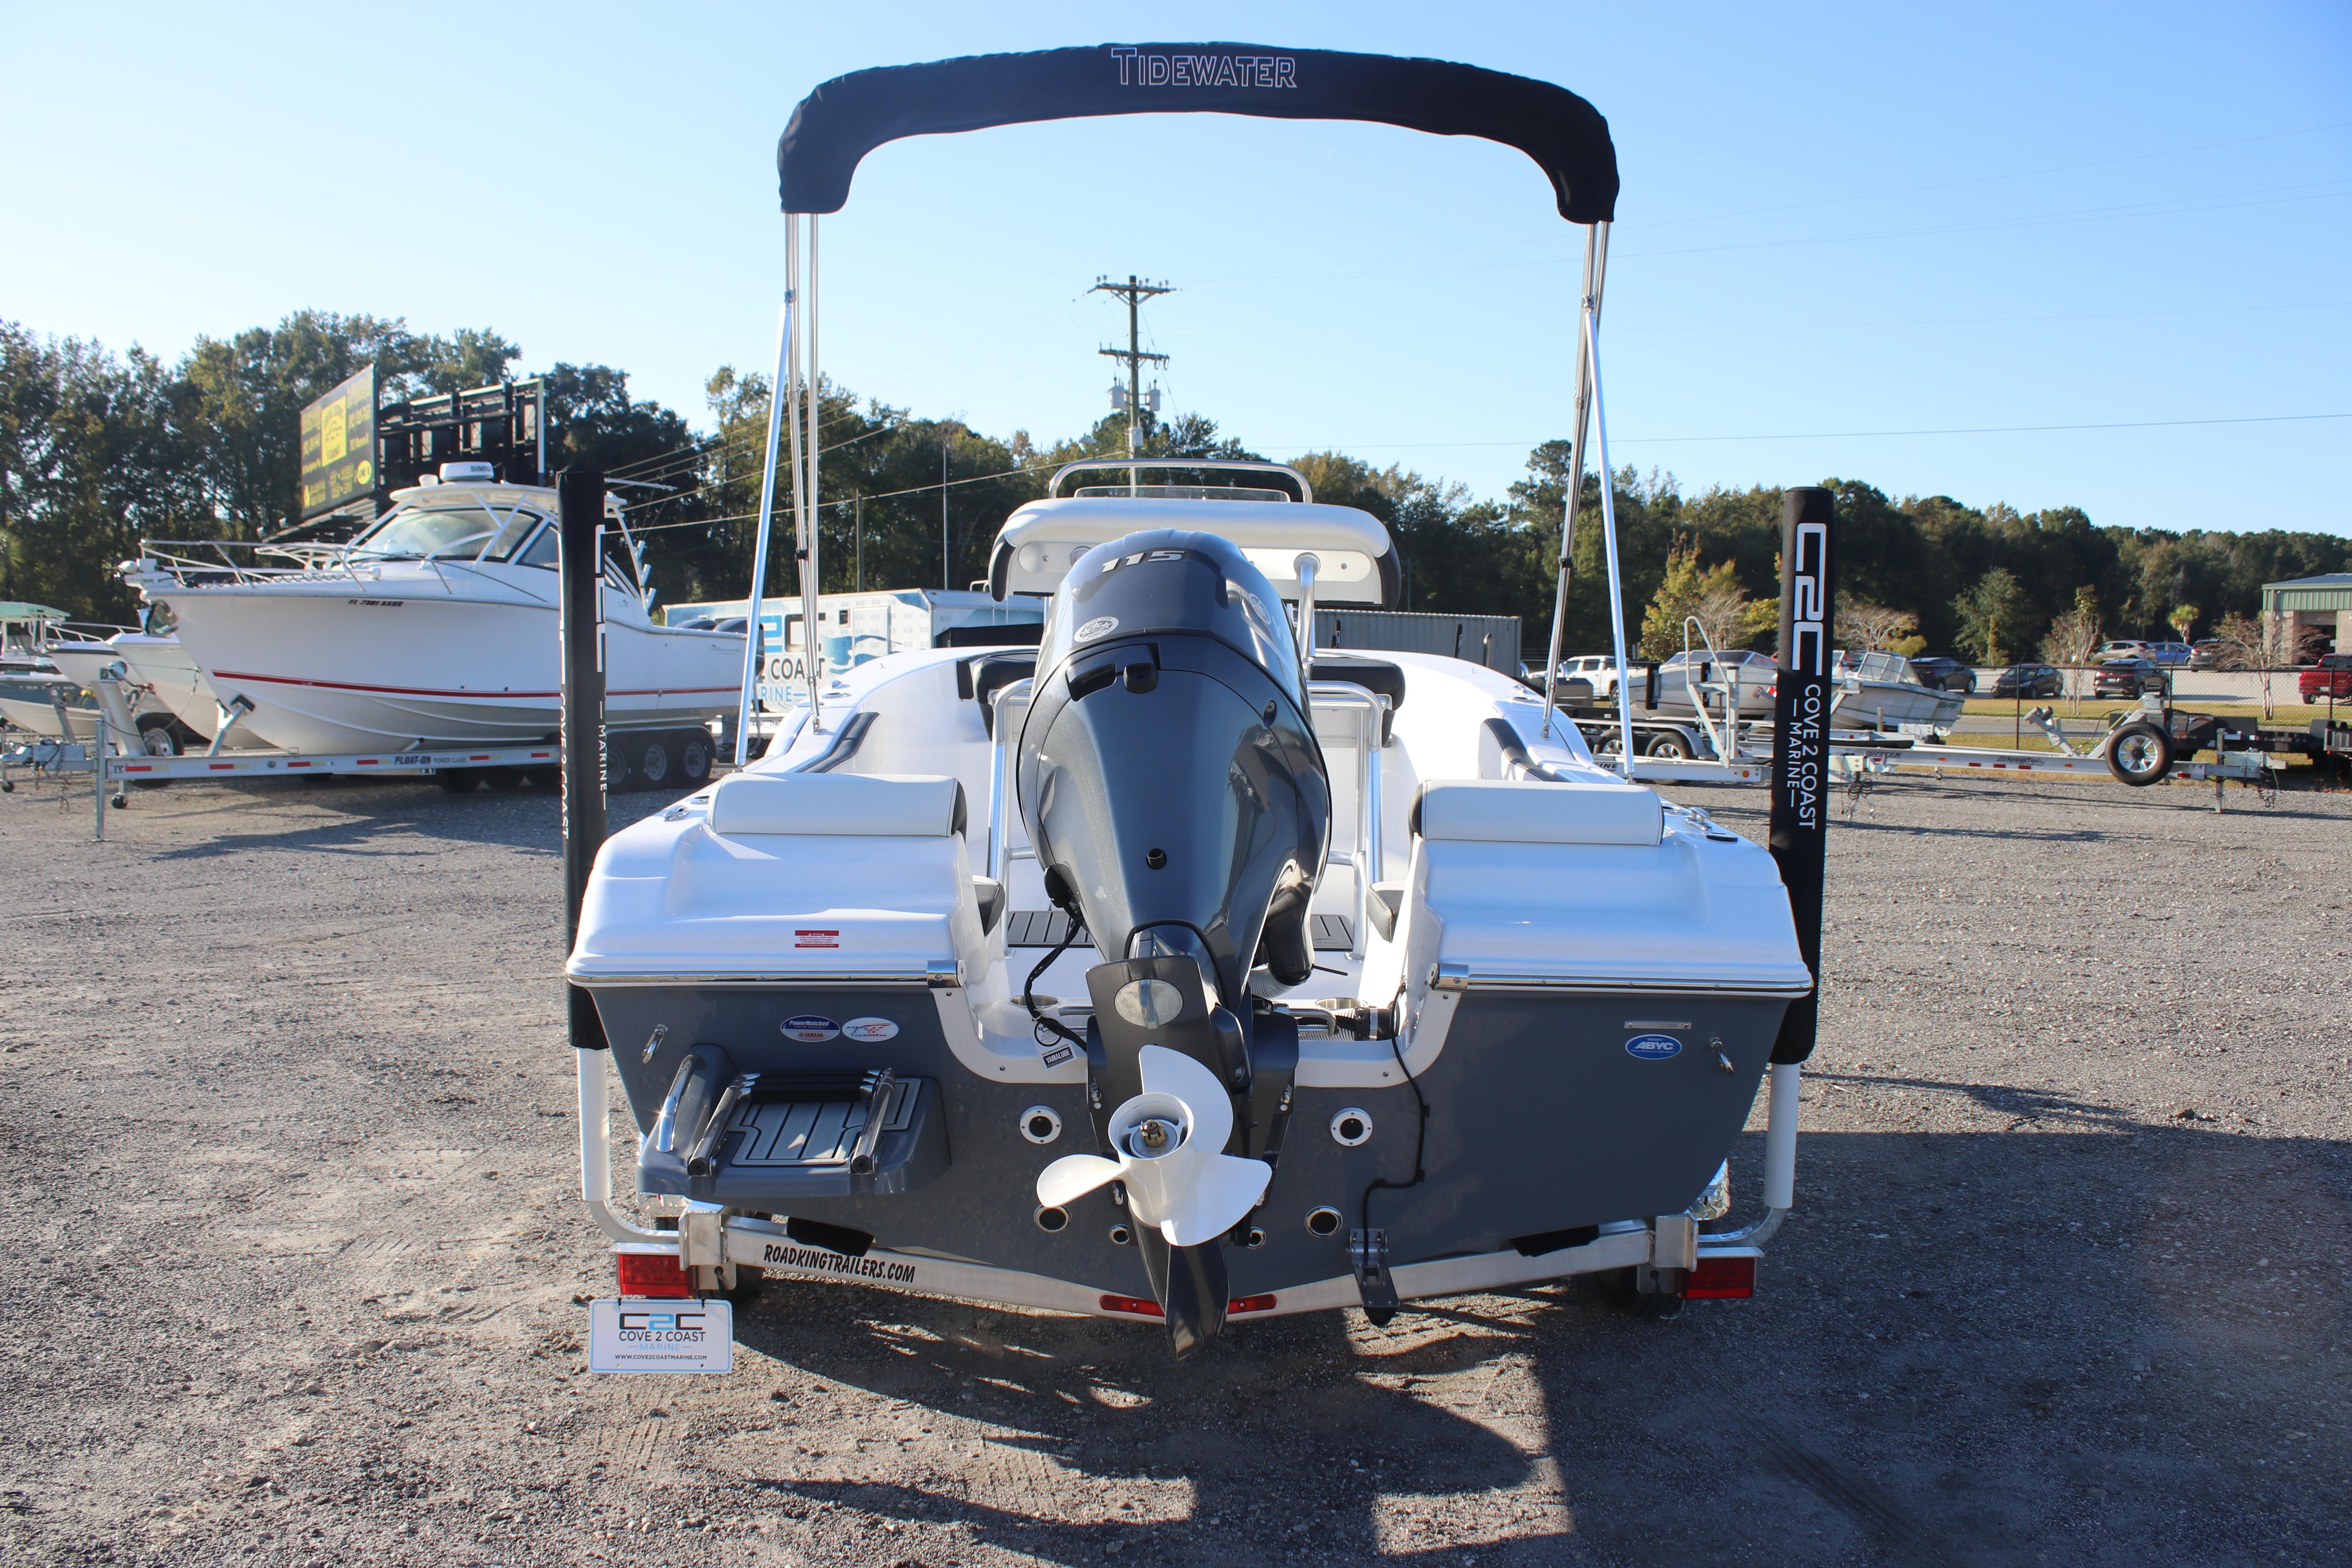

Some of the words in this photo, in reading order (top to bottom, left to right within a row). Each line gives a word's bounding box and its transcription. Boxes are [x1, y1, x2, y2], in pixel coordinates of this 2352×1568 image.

[1111, 47, 1297, 88] TIDEWATER
[1102, 550, 1185, 573] 115
[1792, 523, 1826, 676] C2C
[771, 658, 825, 680] COAT
[760, 686, 792, 702] RINE
[1803, 684, 1821, 739] COVE
[395, 756, 431, 764] FLOAT-ON
[598, 724, 608, 791] MARINE
[1787, 722, 1802, 788] MARINE
[1802, 745, 1818, 756] 2
[1799, 762, 1818, 829] COAST
[1045, 1049, 1071, 1064] YAMALUBE
[1634, 1042, 1674, 1050] ABYC
[764, 1244, 915, 1283] ROADKINGTRAILERS.COM
[619, 1313, 706, 1330] C2C
[619, 1331, 652, 1341] COVE
[655, 1332, 662, 1341] 2
[666, 1331, 706, 1342] COAST
